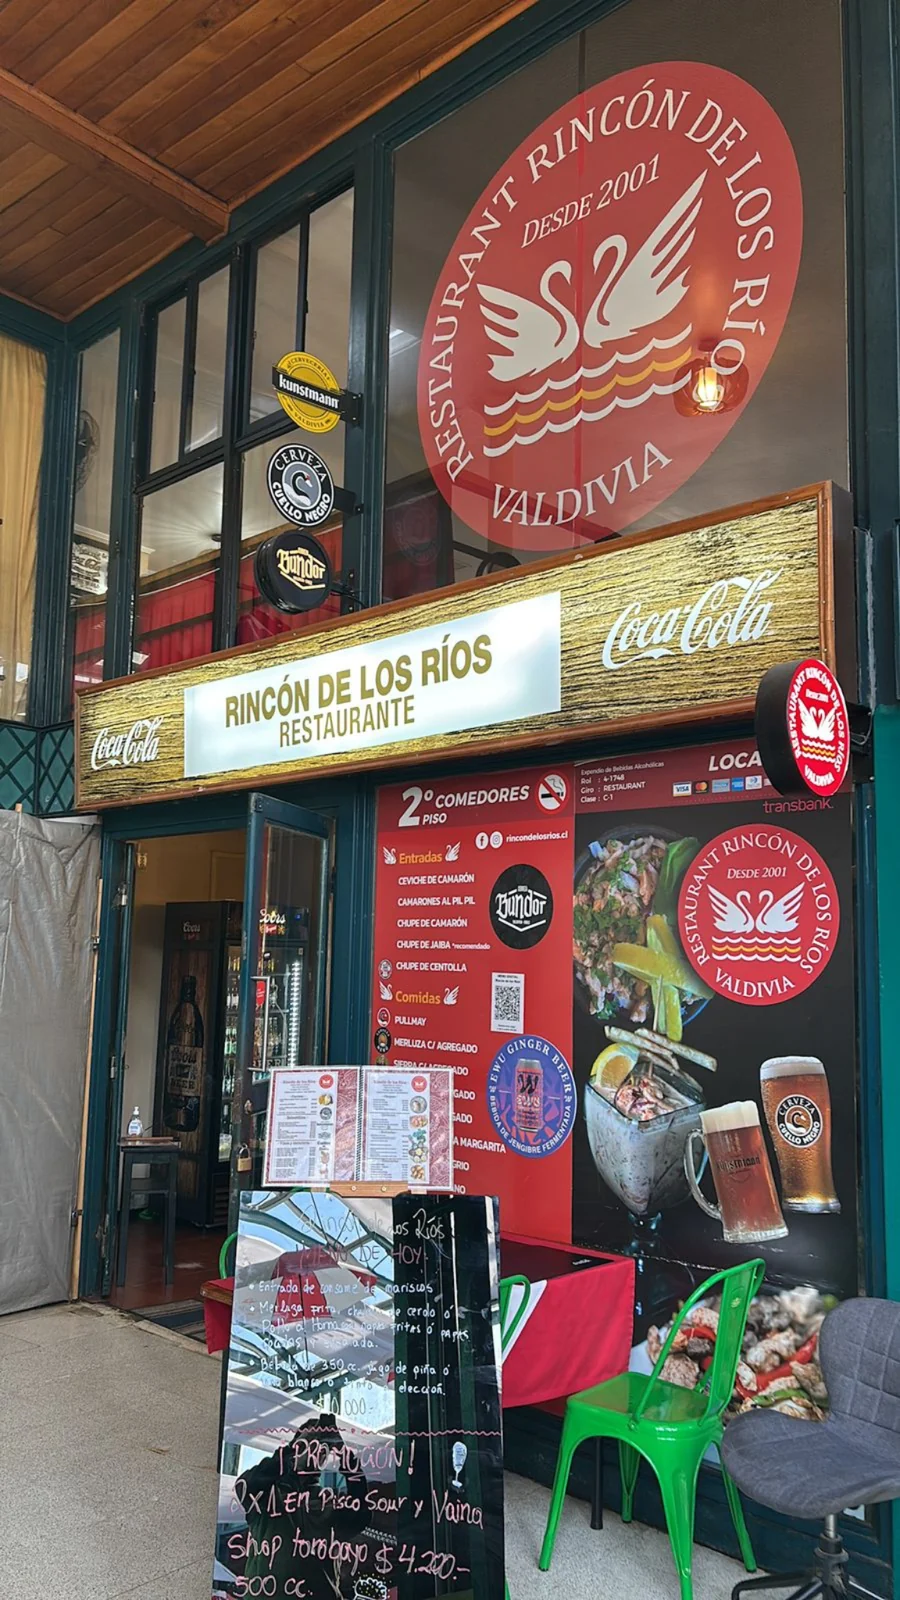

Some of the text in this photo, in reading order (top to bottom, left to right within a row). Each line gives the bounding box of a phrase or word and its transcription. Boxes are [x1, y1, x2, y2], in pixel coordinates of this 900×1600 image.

[520, 153, 661, 249] DESDE 2001
[429, 175, 521, 481] RESTAURANT
[526, 78, 691, 184] RINCÓN
[685, 98, 748, 164] DE
[725, 151, 775, 262] LOS
[279, 374, 340, 409] kunstmann
[275, 448, 327, 484] CERVEZA
[490, 440, 674, 528] VALDIVIA
[272, 480, 331, 523] CUELLO NEGRO
[276, 548, 326, 580] Bundor
[602, 566, 784, 670] Coca-Cola
[225, 633, 493, 729] RINCÓN DE LOS RÍOS
[805, 667, 833, 692] RINCÓN
[830, 690, 841, 711] DE
[279, 694, 415, 748] RESTAURANTE
[835, 712, 845, 739] LOS
[91, 716, 164, 771] Coca-Cola
[708, 751, 762, 772] LOCA
[581, 777, 592, 785] Rol
[603, 781, 646, 792] RESTAURANT
[435, 785, 530, 809] COMEDORES
[422, 813, 447, 826] PISO
[506, 831, 568, 843] rincondelosrios.cl
[399, 851, 442, 865] Entradas
[398, 872, 475, 886] CEVICHE DE CAMARÓN
[761, 866, 787, 878] 2001
[397, 896, 475, 907] CAMARONES AL PIL PIL
[495, 890, 547, 919] Bundor
[684, 832, 832, 975] RESTAURANT RINCÓN DE LOS RÍOS
[397, 916, 467, 928] CHUPE DE CAMARÓN
[397, 940, 419, 950] CHUPE
[420, 940, 429, 950] DE
[430, 940, 451, 950] JAIBA
[396, 961, 467, 972] CHUPE DE CENTOLLA
[714, 967, 796, 998] VALDIVIA
[395, 991, 441, 1005] Comidas
[394, 1016, 426, 1027] PULLMAY
[393, 1037, 426, 1050] MERLUZA
[427, 1040, 437, 1051] C/
[437, 1042, 478, 1054] AGREGADO
[506, 1038, 550, 1056] GINGER
[551, 1055, 572, 1094] BEER
[779, 1097, 816, 1116] CERVEZA
[489, 1095, 501, 1128] BEBIDA
[499, 1127, 508, 1139] DE
[508, 1136, 542, 1154] JENGIBRE
[542, 1105, 571, 1152] FERMENTADA
[779, 1121, 820, 1145] CUELLO NEGRO
[460, 1137, 506, 1154] MARGARITA
[259, 1281, 299, 1294] Entrada
[303, 1279, 315, 1294] de
[321, 1359, 345, 1372] 350
[395, 1361, 407, 1375] de
[364, 1489, 408, 1514] Sour
[432, 1489, 484, 1530] Vaina
[233, 1575, 277, 1599] 500
